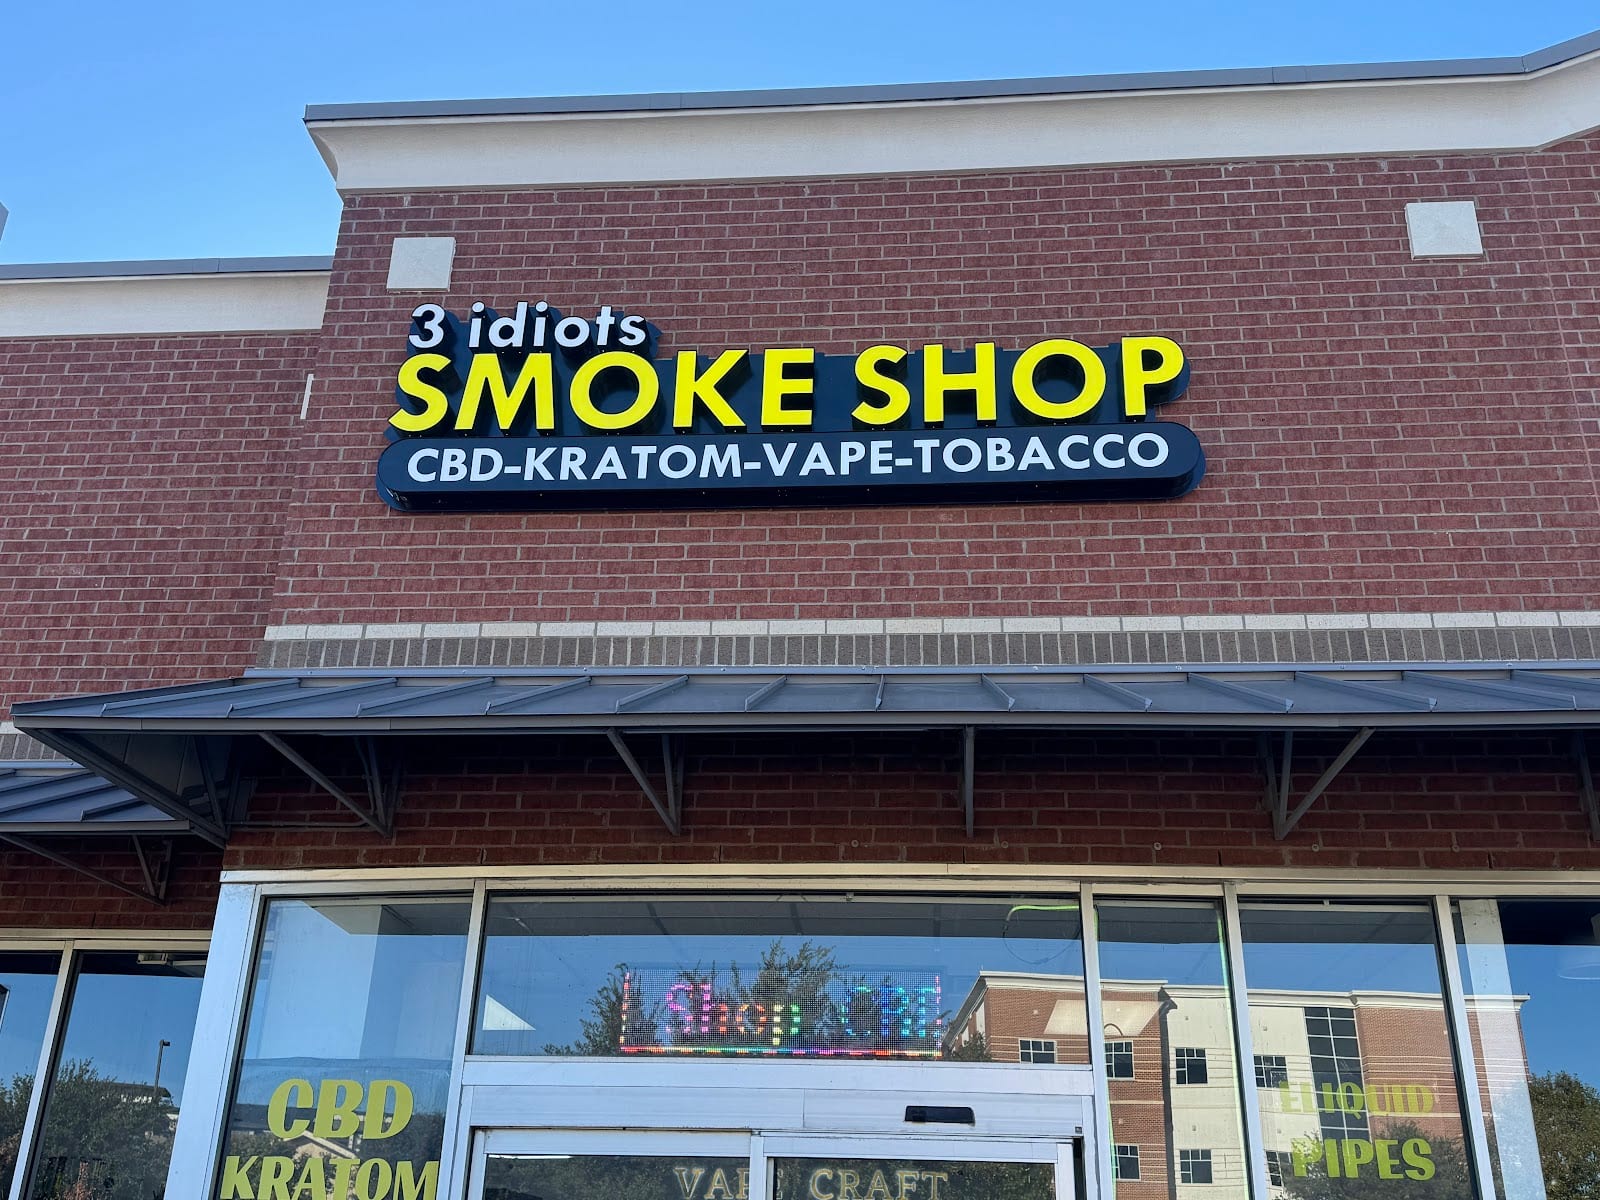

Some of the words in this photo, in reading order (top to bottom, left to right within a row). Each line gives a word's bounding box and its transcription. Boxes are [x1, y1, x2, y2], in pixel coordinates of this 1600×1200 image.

[408, 303, 446, 349] 3
[468, 301, 646, 348] idiots
[388, 347, 815, 432] SMOKE
[851, 336, 1185, 425] SHOP
[267, 1078, 414, 1140] CBD
[220, 1155, 440, 1200] KRATOM
[1290, 1138, 1436, 1181] PIPES
[809, 1167, 949, 1200] CRAFT
